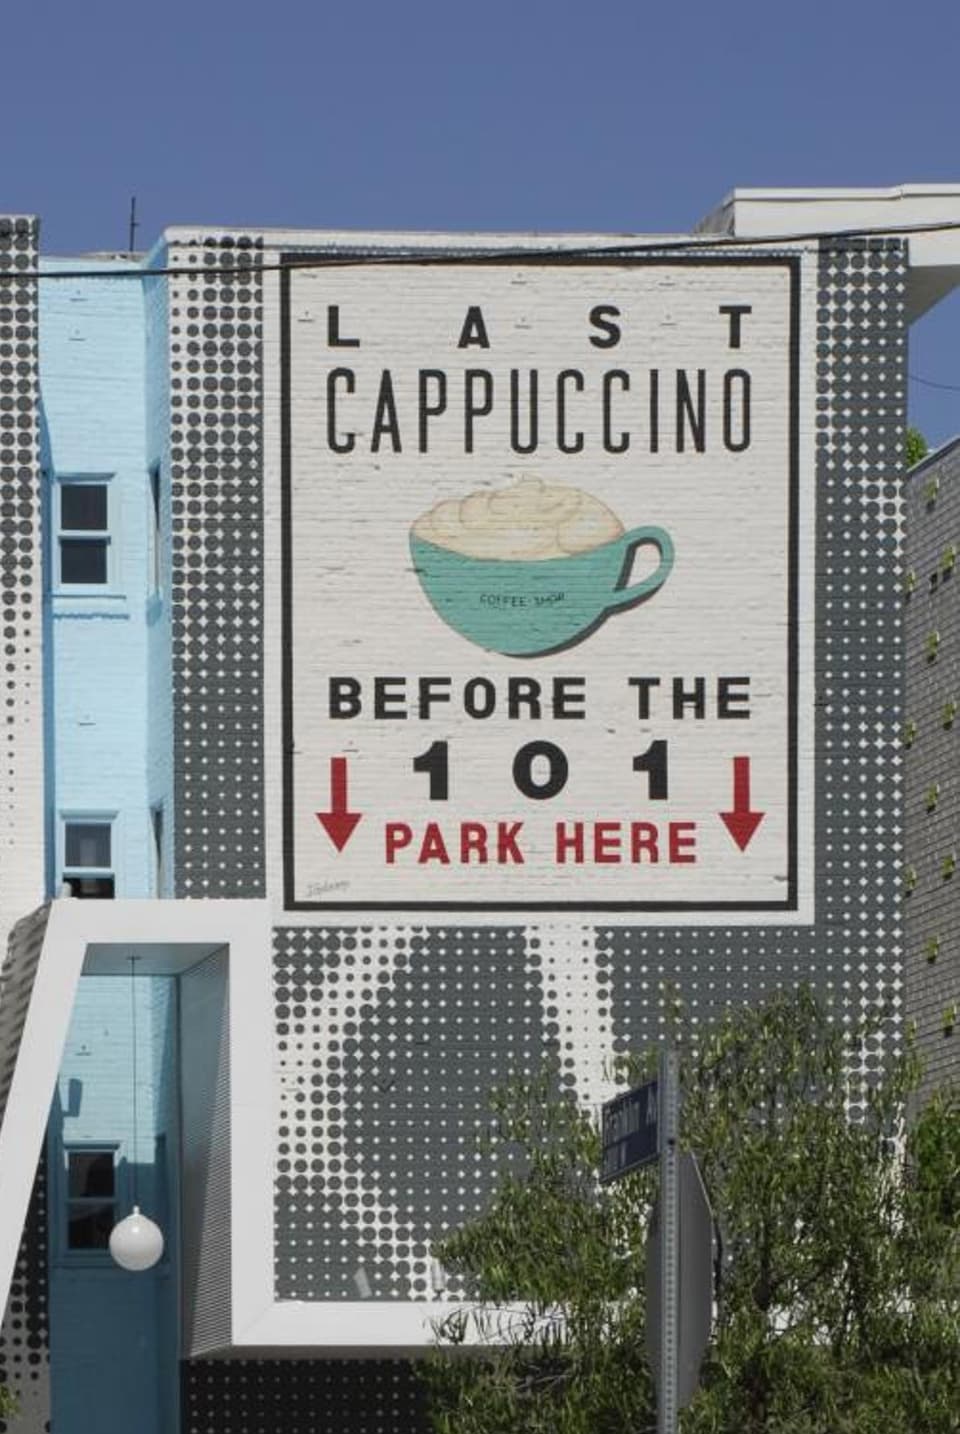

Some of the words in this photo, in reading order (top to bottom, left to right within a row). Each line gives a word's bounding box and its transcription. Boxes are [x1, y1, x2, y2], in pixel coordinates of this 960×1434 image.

[327, 305, 752, 349] LAST
[326, 367, 751, 454] CAPPUCCINO
[329, 676, 586, 720] BEFORE
[628, 676, 751, 720] THE
[413, 739, 668, 801] 101
[385, 822, 525, 865] PARK
[556, 821, 696, 864] HERE
